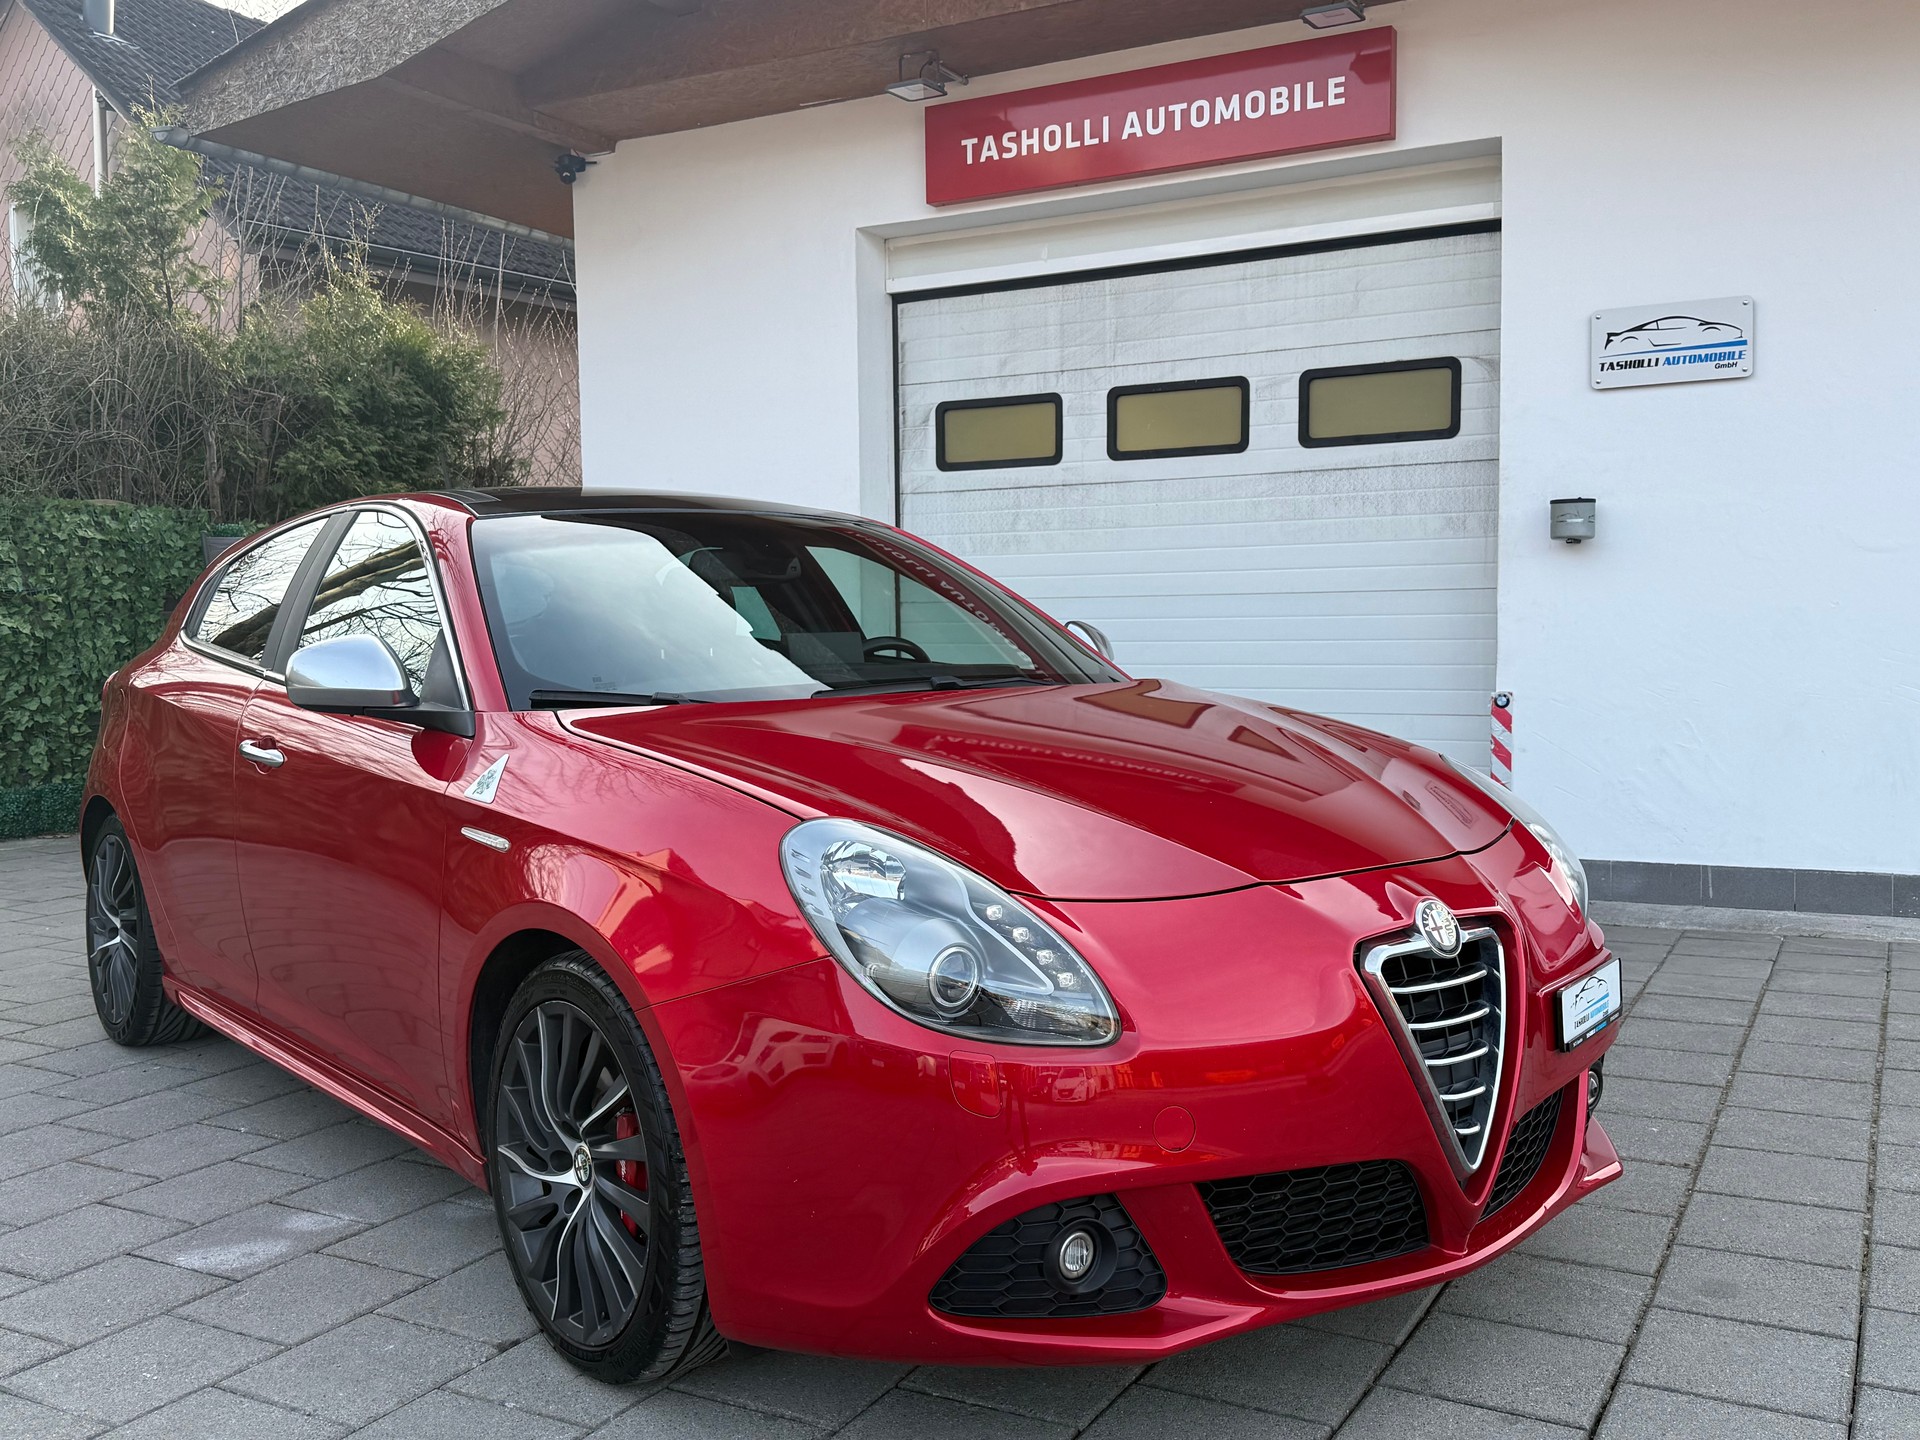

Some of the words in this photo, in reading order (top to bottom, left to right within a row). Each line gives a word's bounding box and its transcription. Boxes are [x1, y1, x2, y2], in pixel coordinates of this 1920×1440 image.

[961, 115, 1110, 165] TASHOLLI
[1121, 75, 1347, 140] AUTOMOBILE
[1599, 357, 1660, 372] TASHOLLI
[1662, 350, 1746, 366] AUTOMOBILE
[1714, 361, 1739, 370] GmbH
